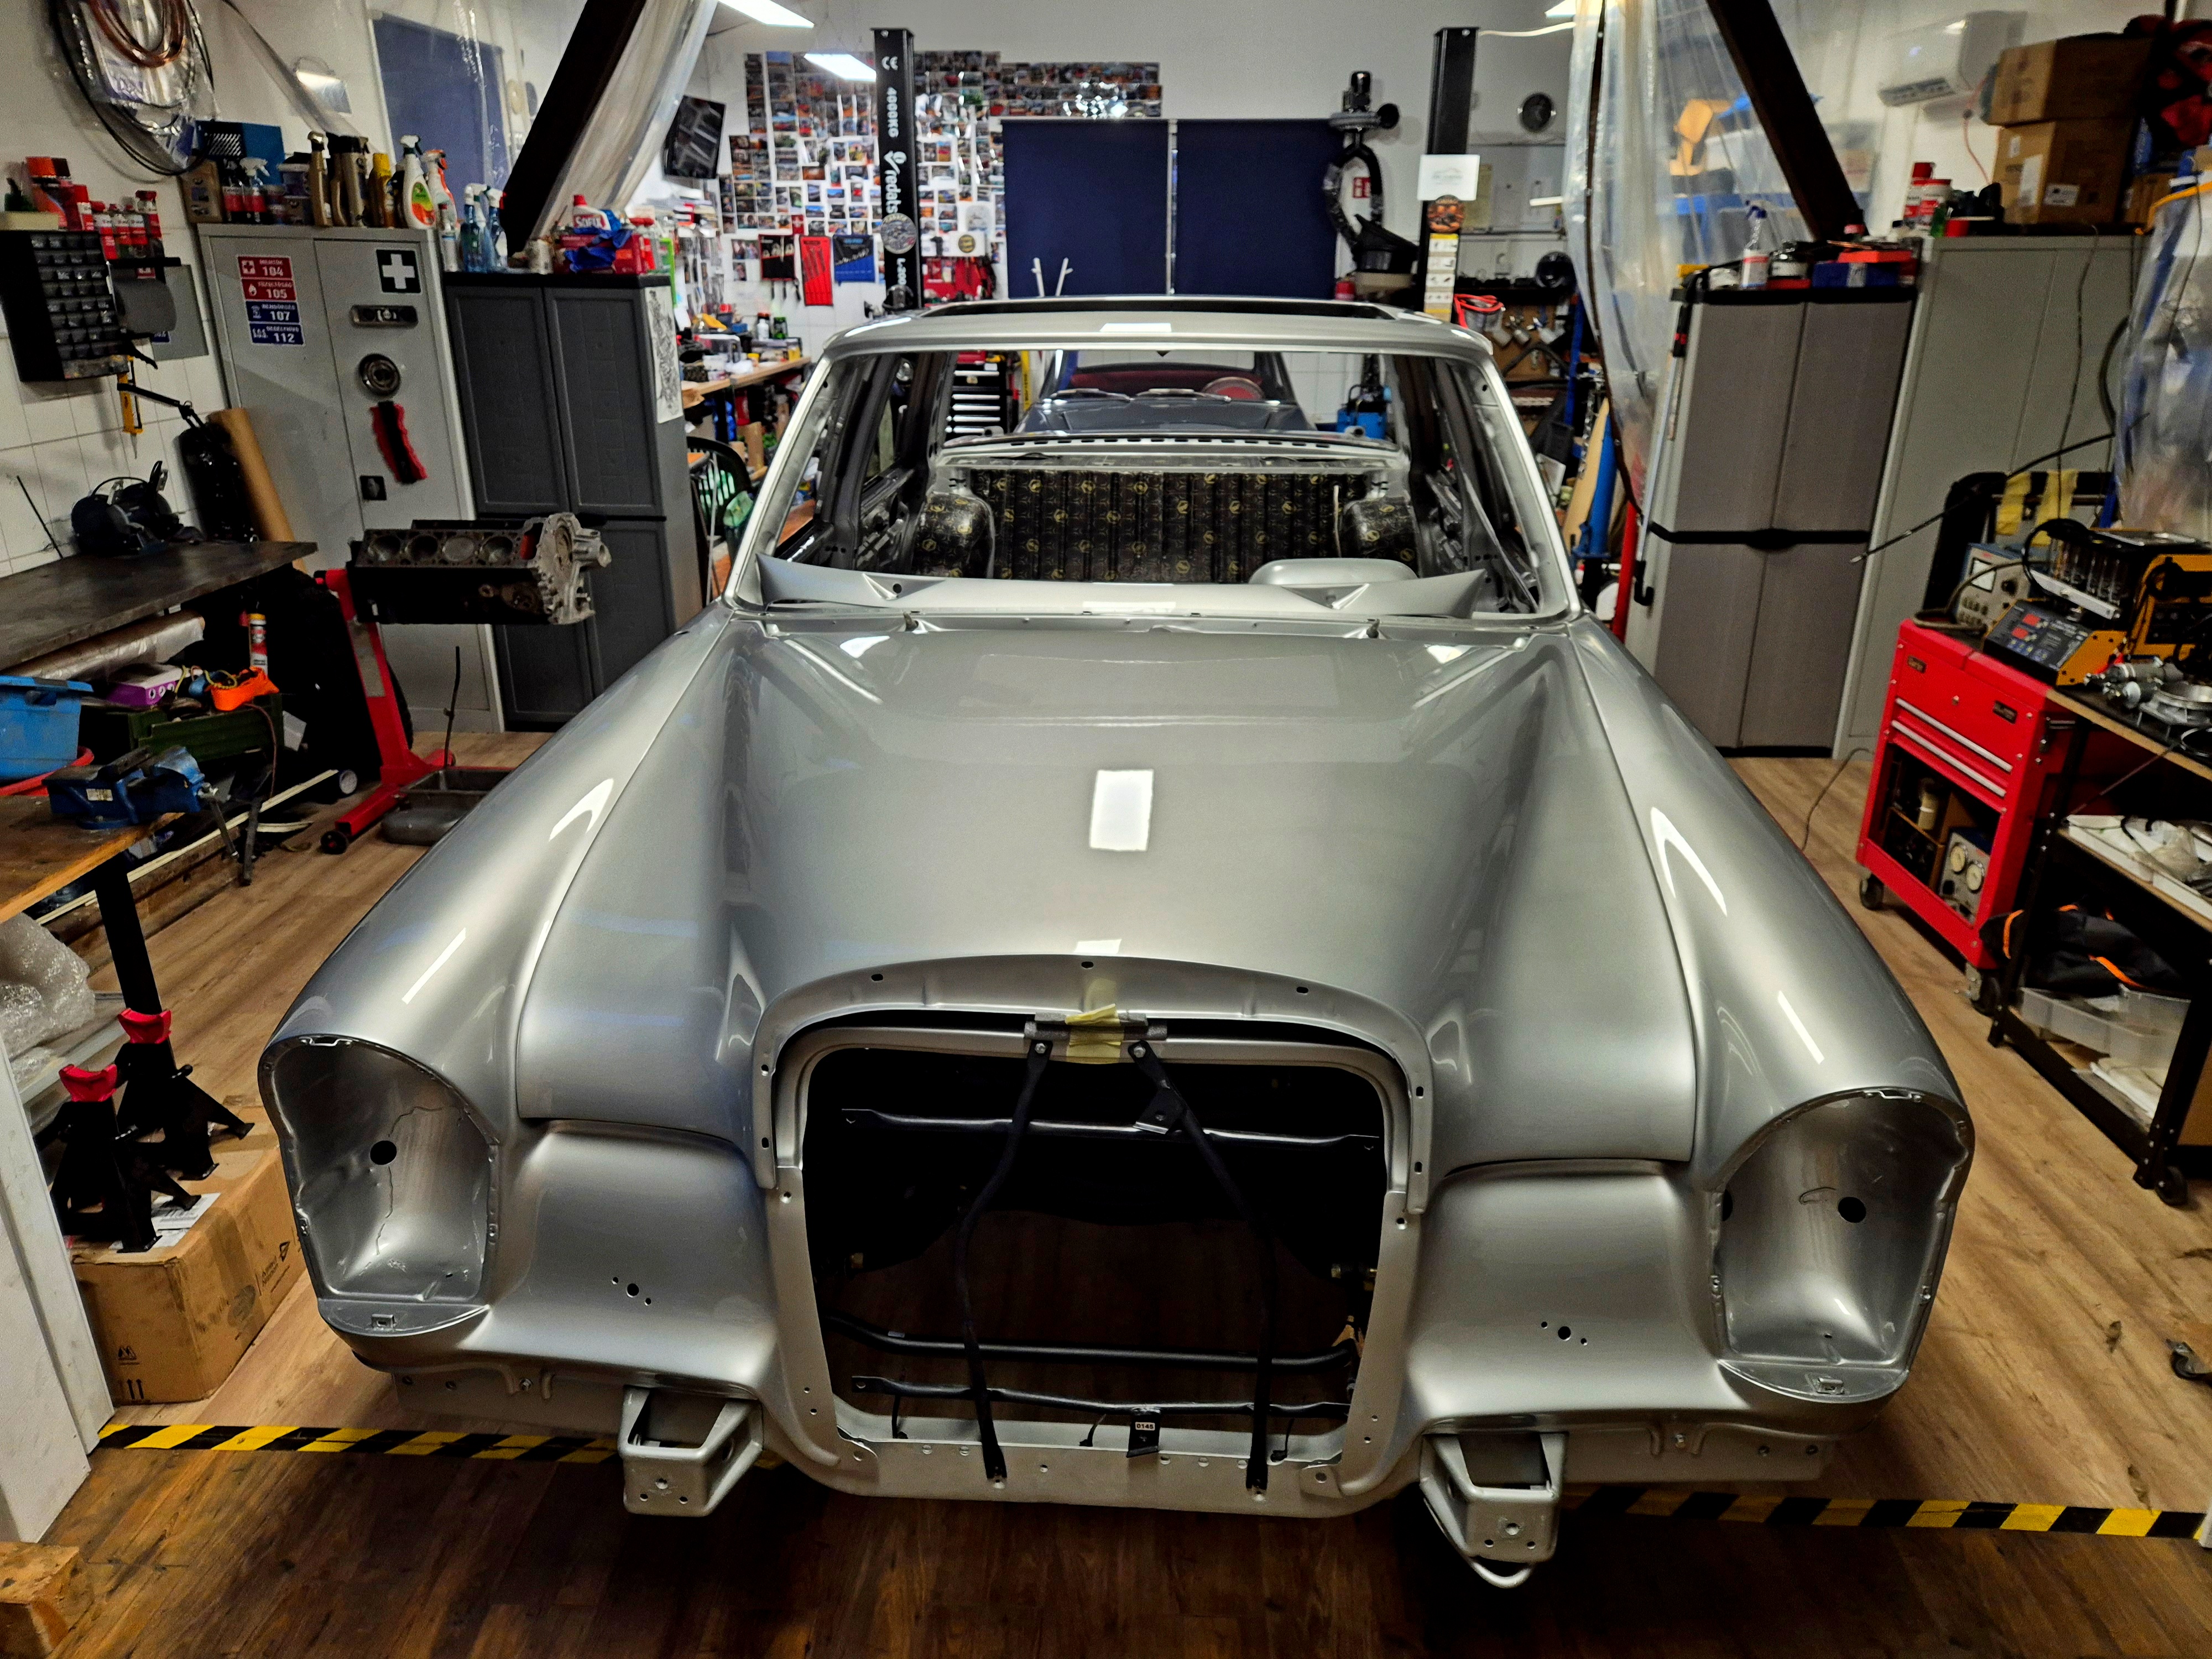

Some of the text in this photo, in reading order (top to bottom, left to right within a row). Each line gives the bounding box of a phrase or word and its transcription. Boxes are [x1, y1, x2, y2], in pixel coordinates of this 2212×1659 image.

[881, 56, 898, 71] CE
[886, 86, 899, 138] 4000KG
[263, 266, 284, 276] 104
[266, 288, 288, 299] 105
[270, 310, 290, 321] 107
[274, 333, 295, 343] 112
